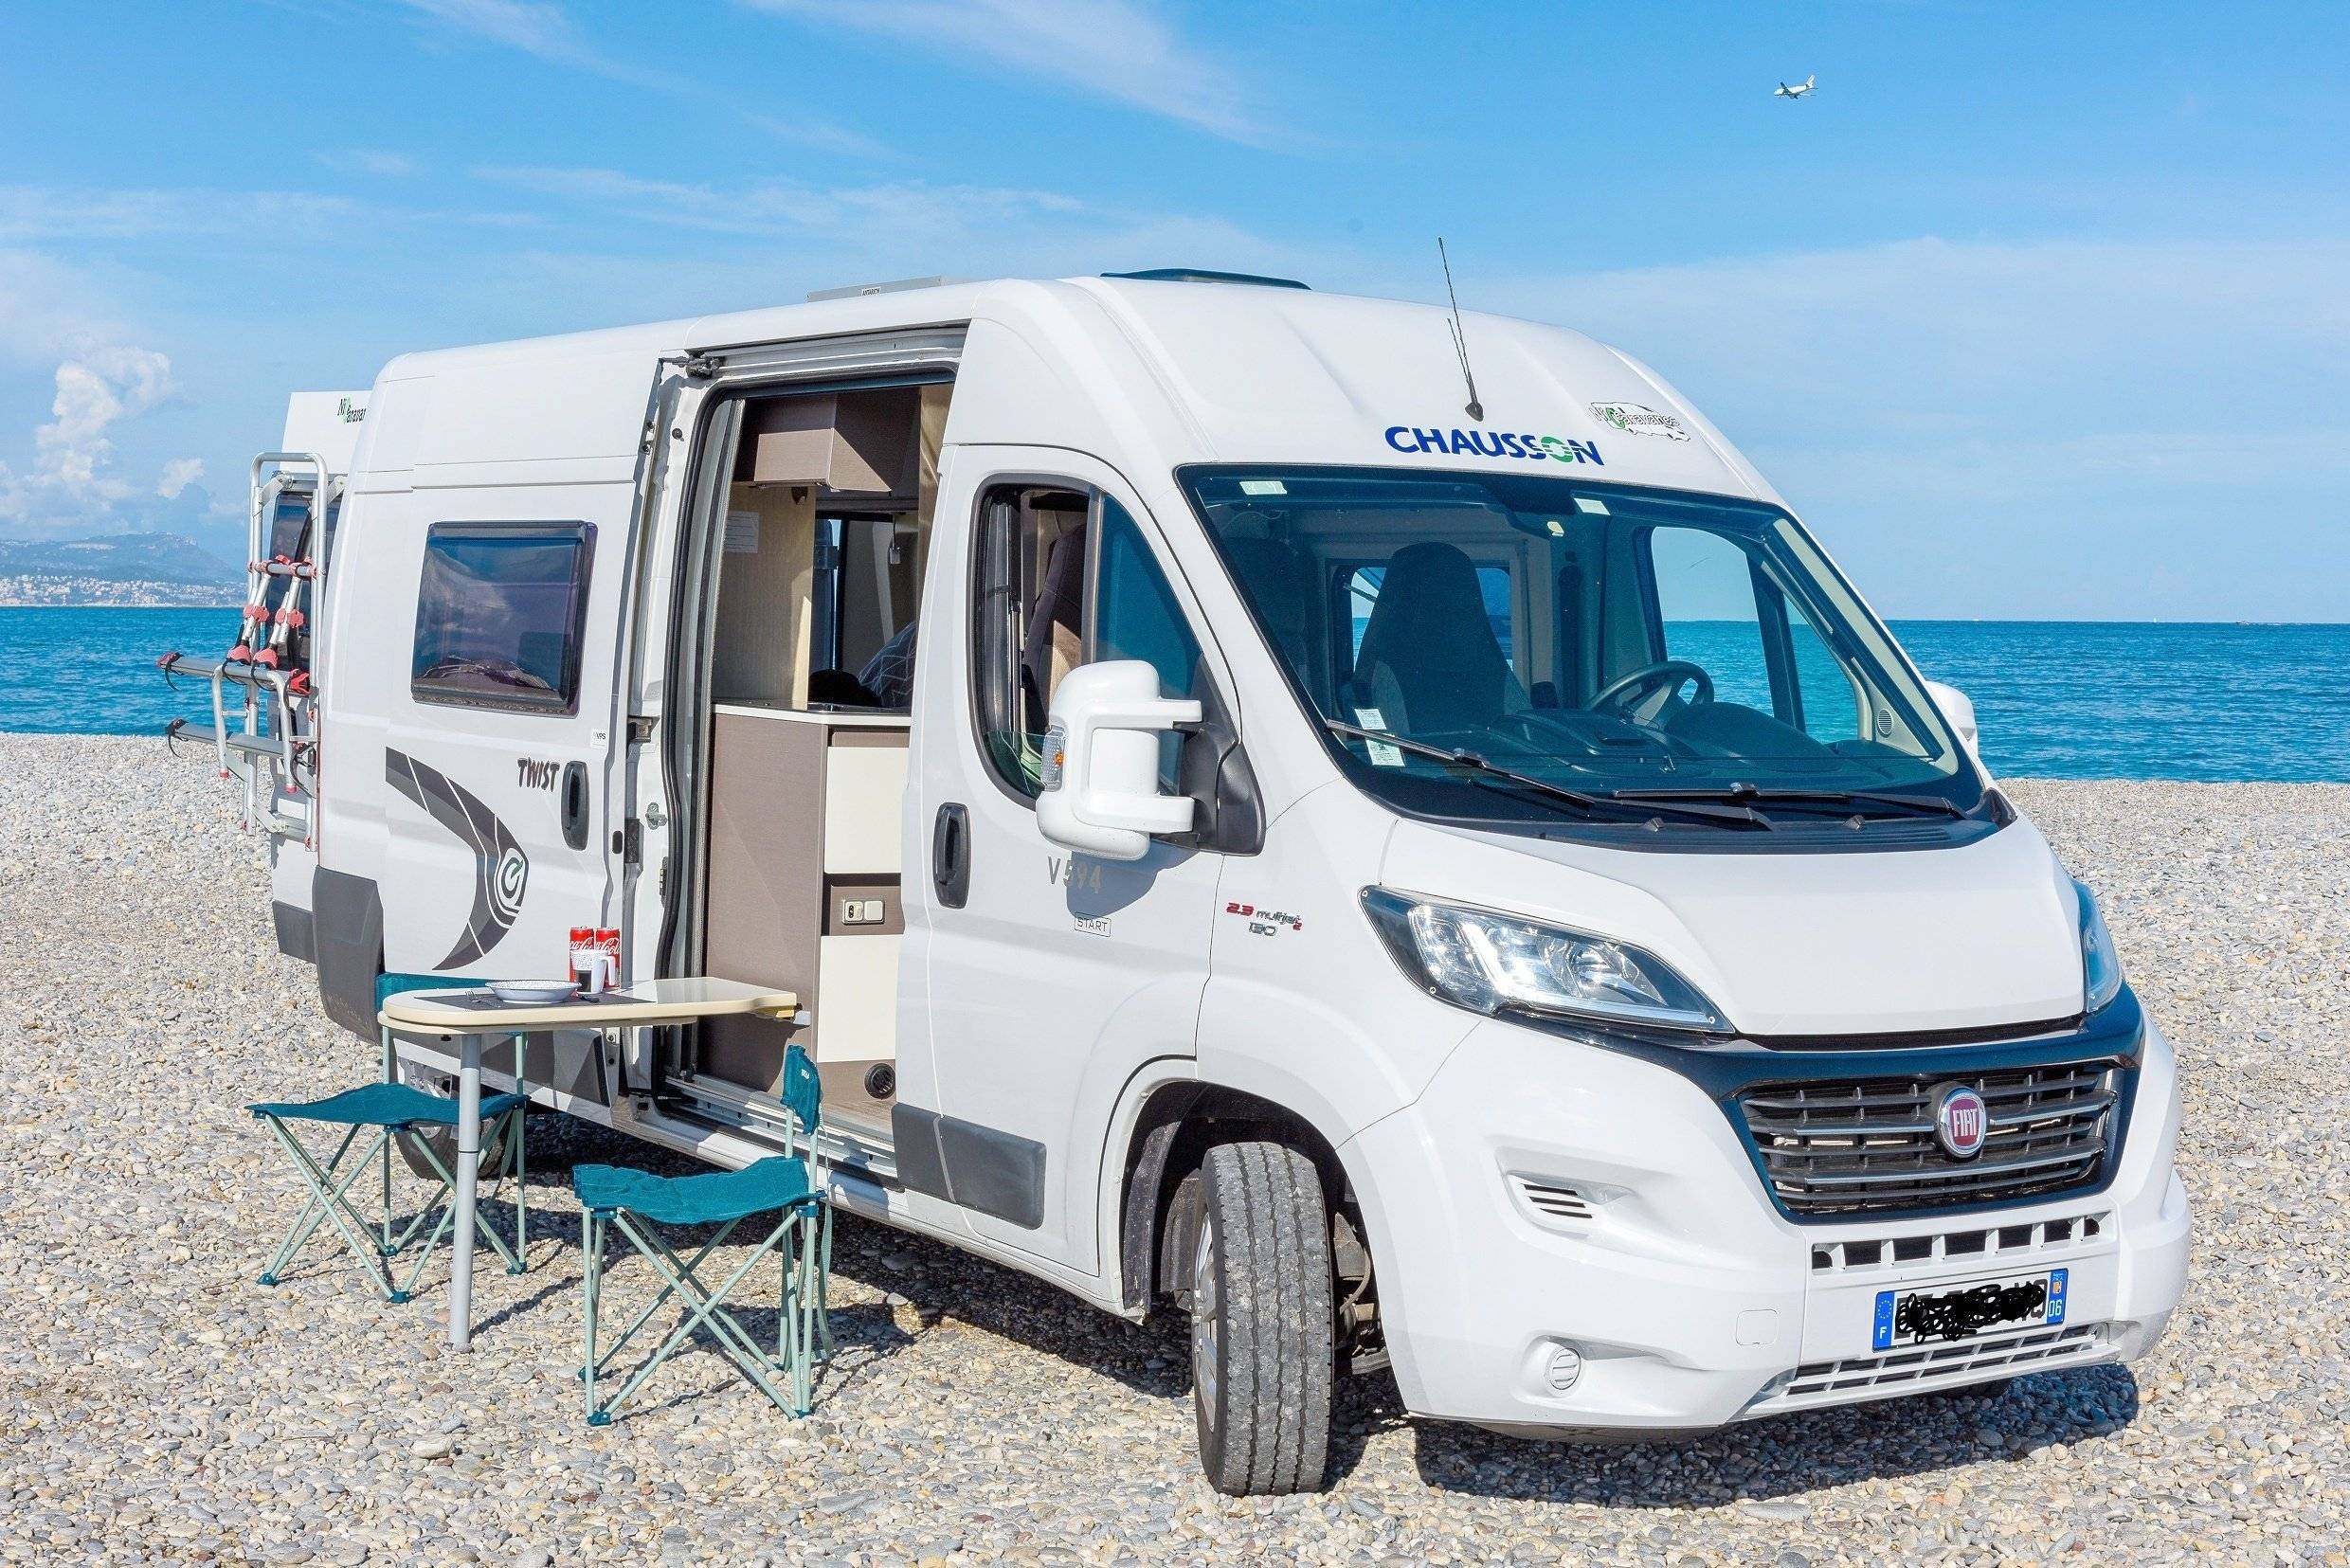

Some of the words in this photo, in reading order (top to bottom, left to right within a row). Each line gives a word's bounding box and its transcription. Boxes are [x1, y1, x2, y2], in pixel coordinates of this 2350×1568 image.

[1385, 426, 1604, 465] CHAUSSON
[517, 757, 560, 792] TWIST
[1076, 918, 1109, 933] START
[1952, 1108, 1978, 1137] FIAT
[2048, 1299, 2062, 1317] 06
[1879, 1326, 1887, 1340] F
